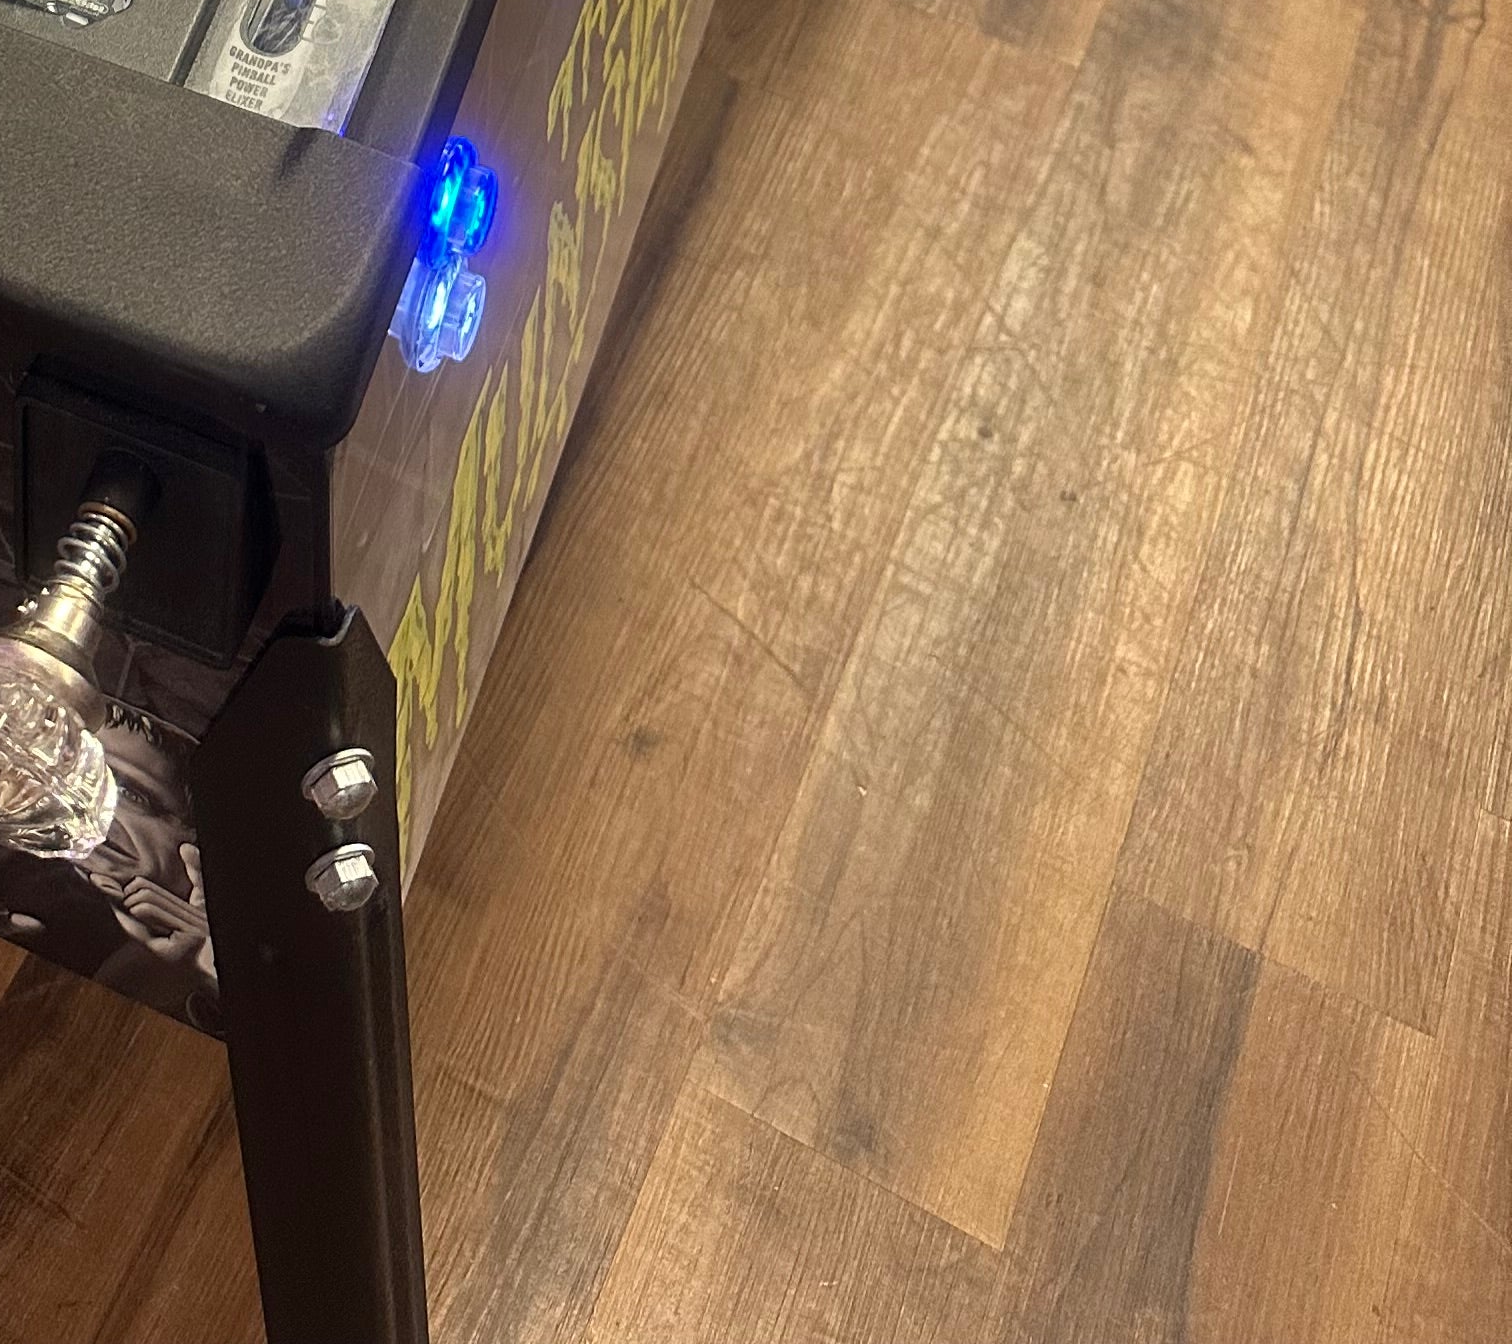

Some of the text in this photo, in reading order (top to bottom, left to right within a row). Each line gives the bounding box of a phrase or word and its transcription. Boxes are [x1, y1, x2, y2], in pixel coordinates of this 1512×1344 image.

[229, 45, 292, 76] GRANDPA'S
[230, 62, 277, 87] PINBALL
[229, 77, 269, 99] POWER
[225, 90, 265, 111] ELIXER
